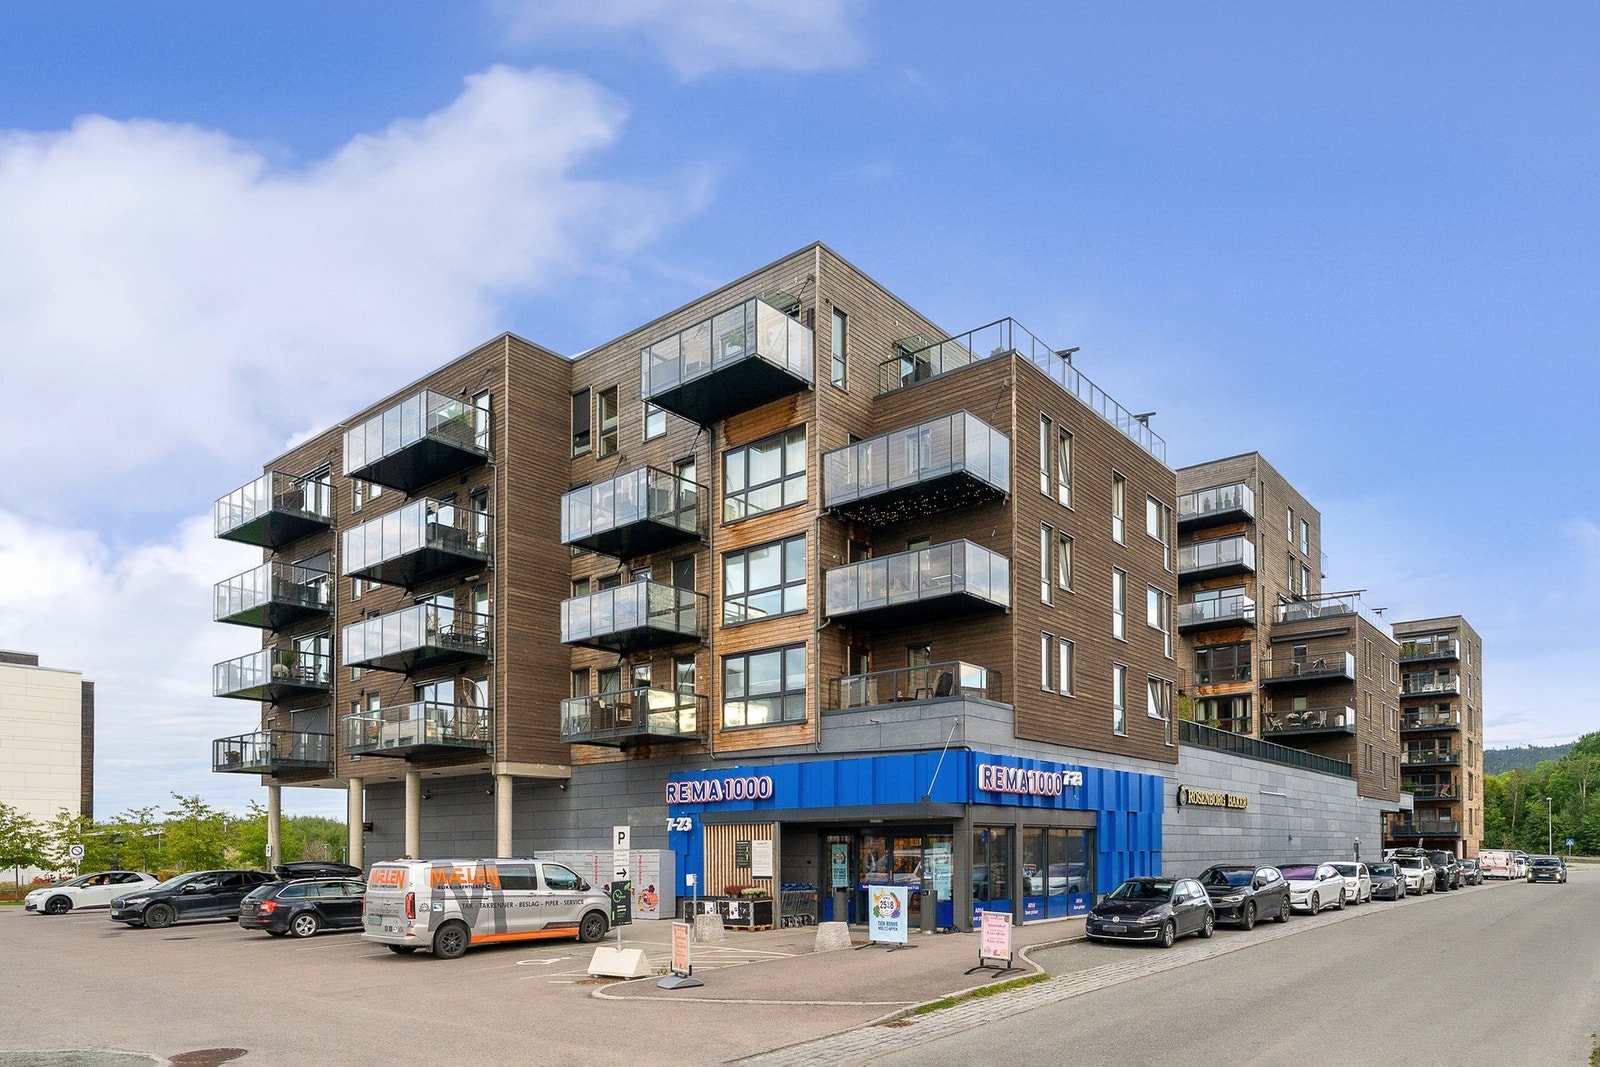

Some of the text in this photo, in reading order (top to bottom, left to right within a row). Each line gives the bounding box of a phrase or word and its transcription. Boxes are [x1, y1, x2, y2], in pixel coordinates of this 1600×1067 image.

[665, 775, 773, 804] REMA 1000
[978, 764, 1063, 796] REMA 1000
[1188, 789, 1226, 807] ROSENBORG
[666, 817, 693, 832] 7-23
[618, 831, 626, 845] P
[369, 869, 406, 890] MÆLEN
[430, 867, 500, 889] MÆLEN
[461, 898, 585, 910] TAK TAKRENNER BESLAG PIPER SERVICE
